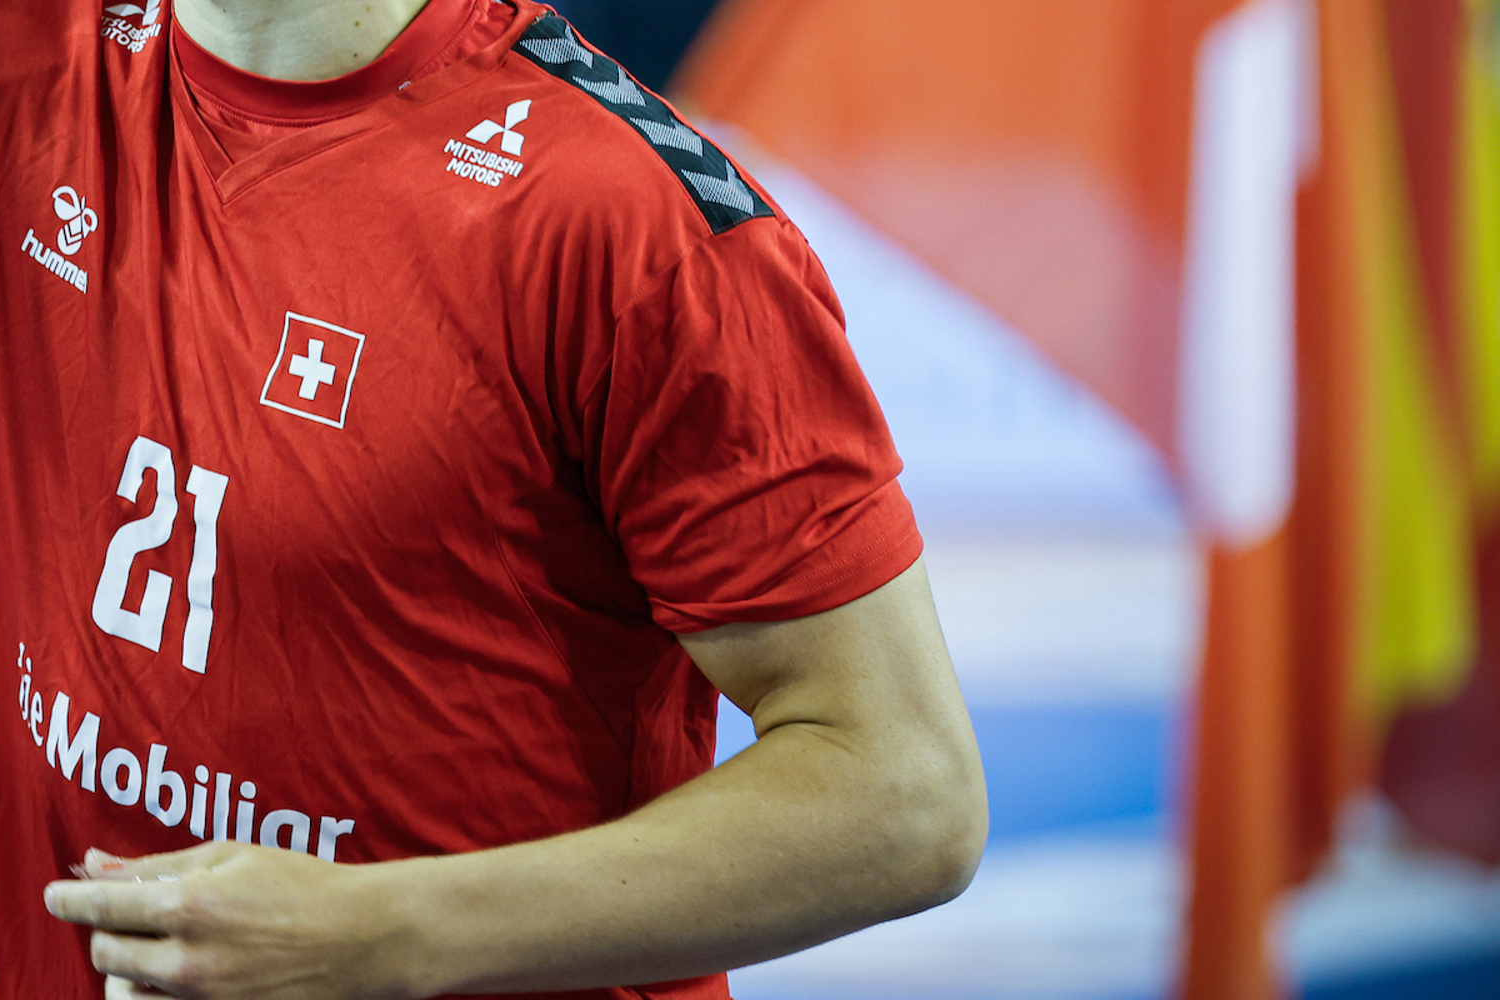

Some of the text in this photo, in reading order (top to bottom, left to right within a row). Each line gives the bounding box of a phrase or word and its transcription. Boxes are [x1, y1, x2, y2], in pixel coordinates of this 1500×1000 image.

[443, 138, 525, 178] MITSUBISHI
[445, 157, 505, 188] MOTORS
[92, 435, 230, 674] 21
